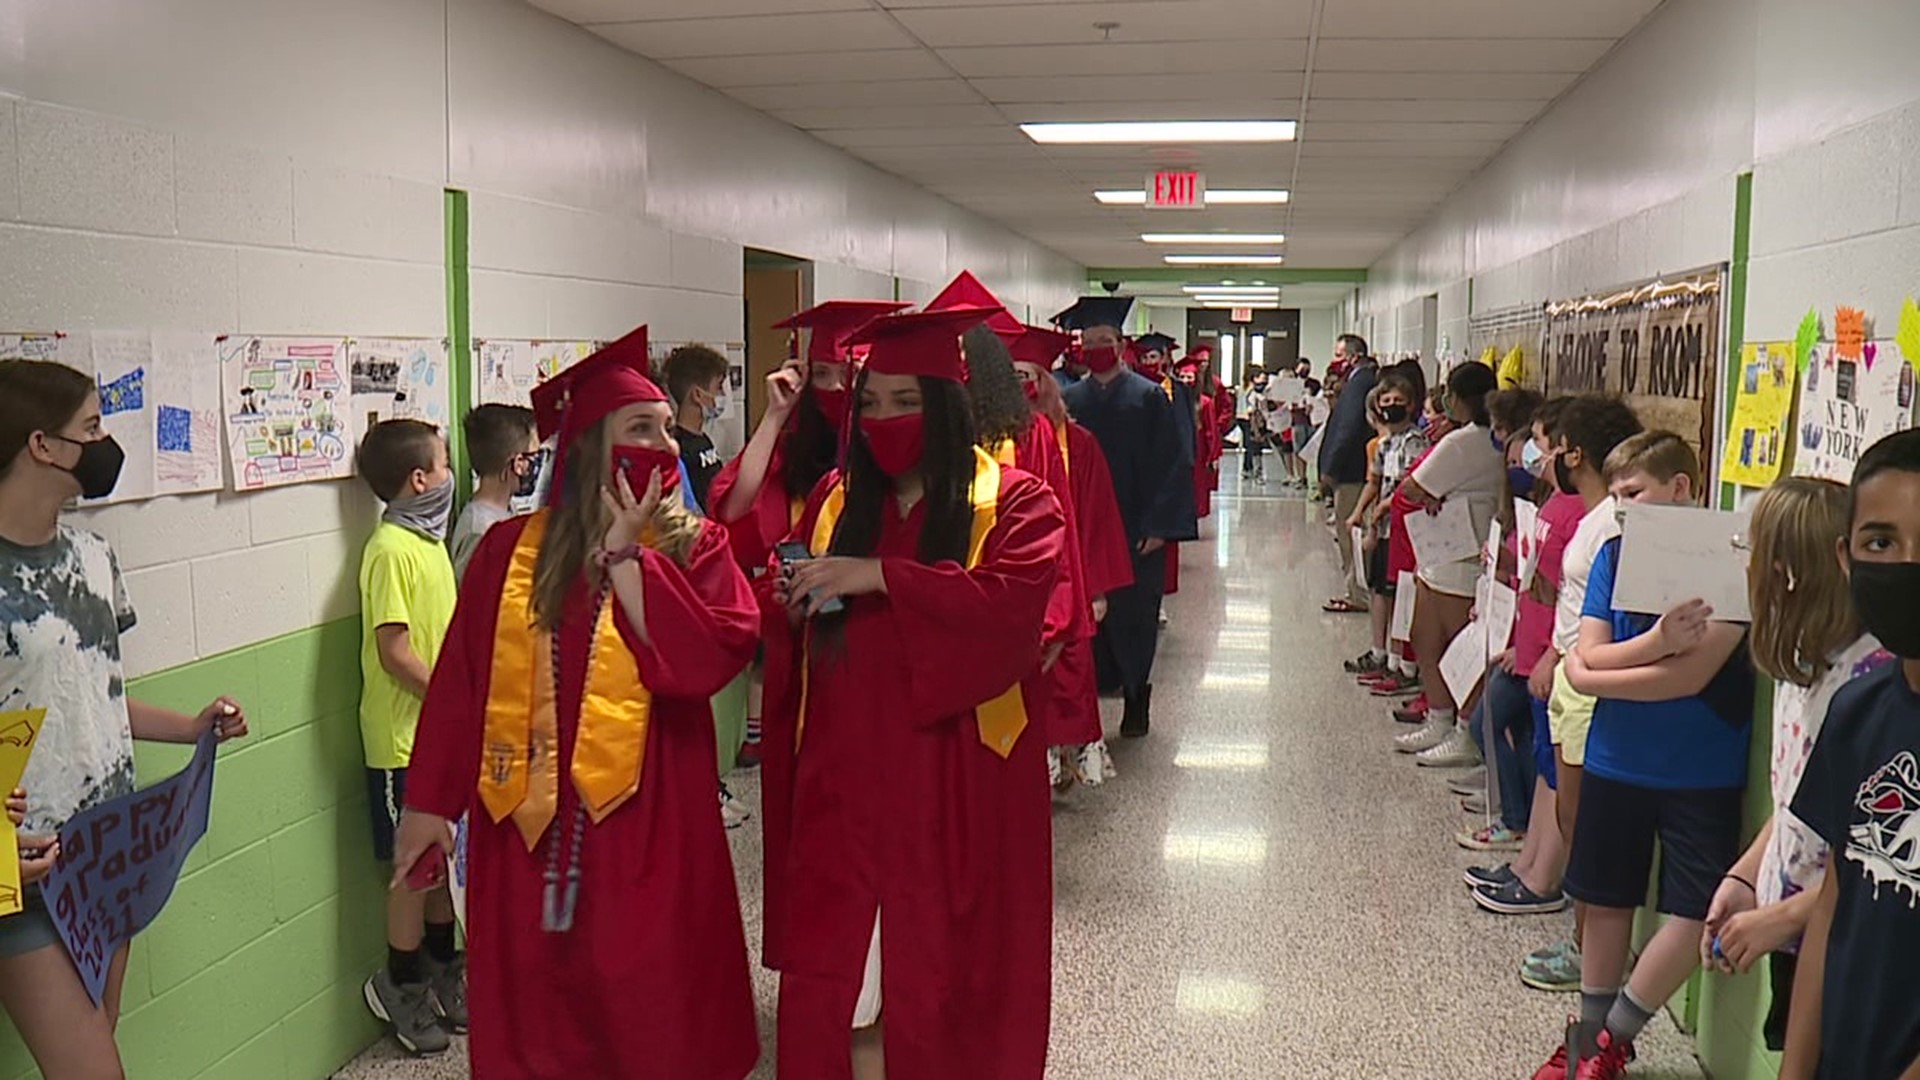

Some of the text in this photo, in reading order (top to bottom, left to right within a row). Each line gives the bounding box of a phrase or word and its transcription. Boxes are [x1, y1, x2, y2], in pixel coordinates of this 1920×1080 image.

[1155, 171, 1197, 204] EXIT
[1621, 328, 1638, 394] TO
[1649, 323, 1702, 400] ROOM
[1826, 400, 1869, 434] NEW
[1825, 426, 1863, 462] YORK
[116, 871, 148, 906] of
[84, 903, 139, 980] 2021
